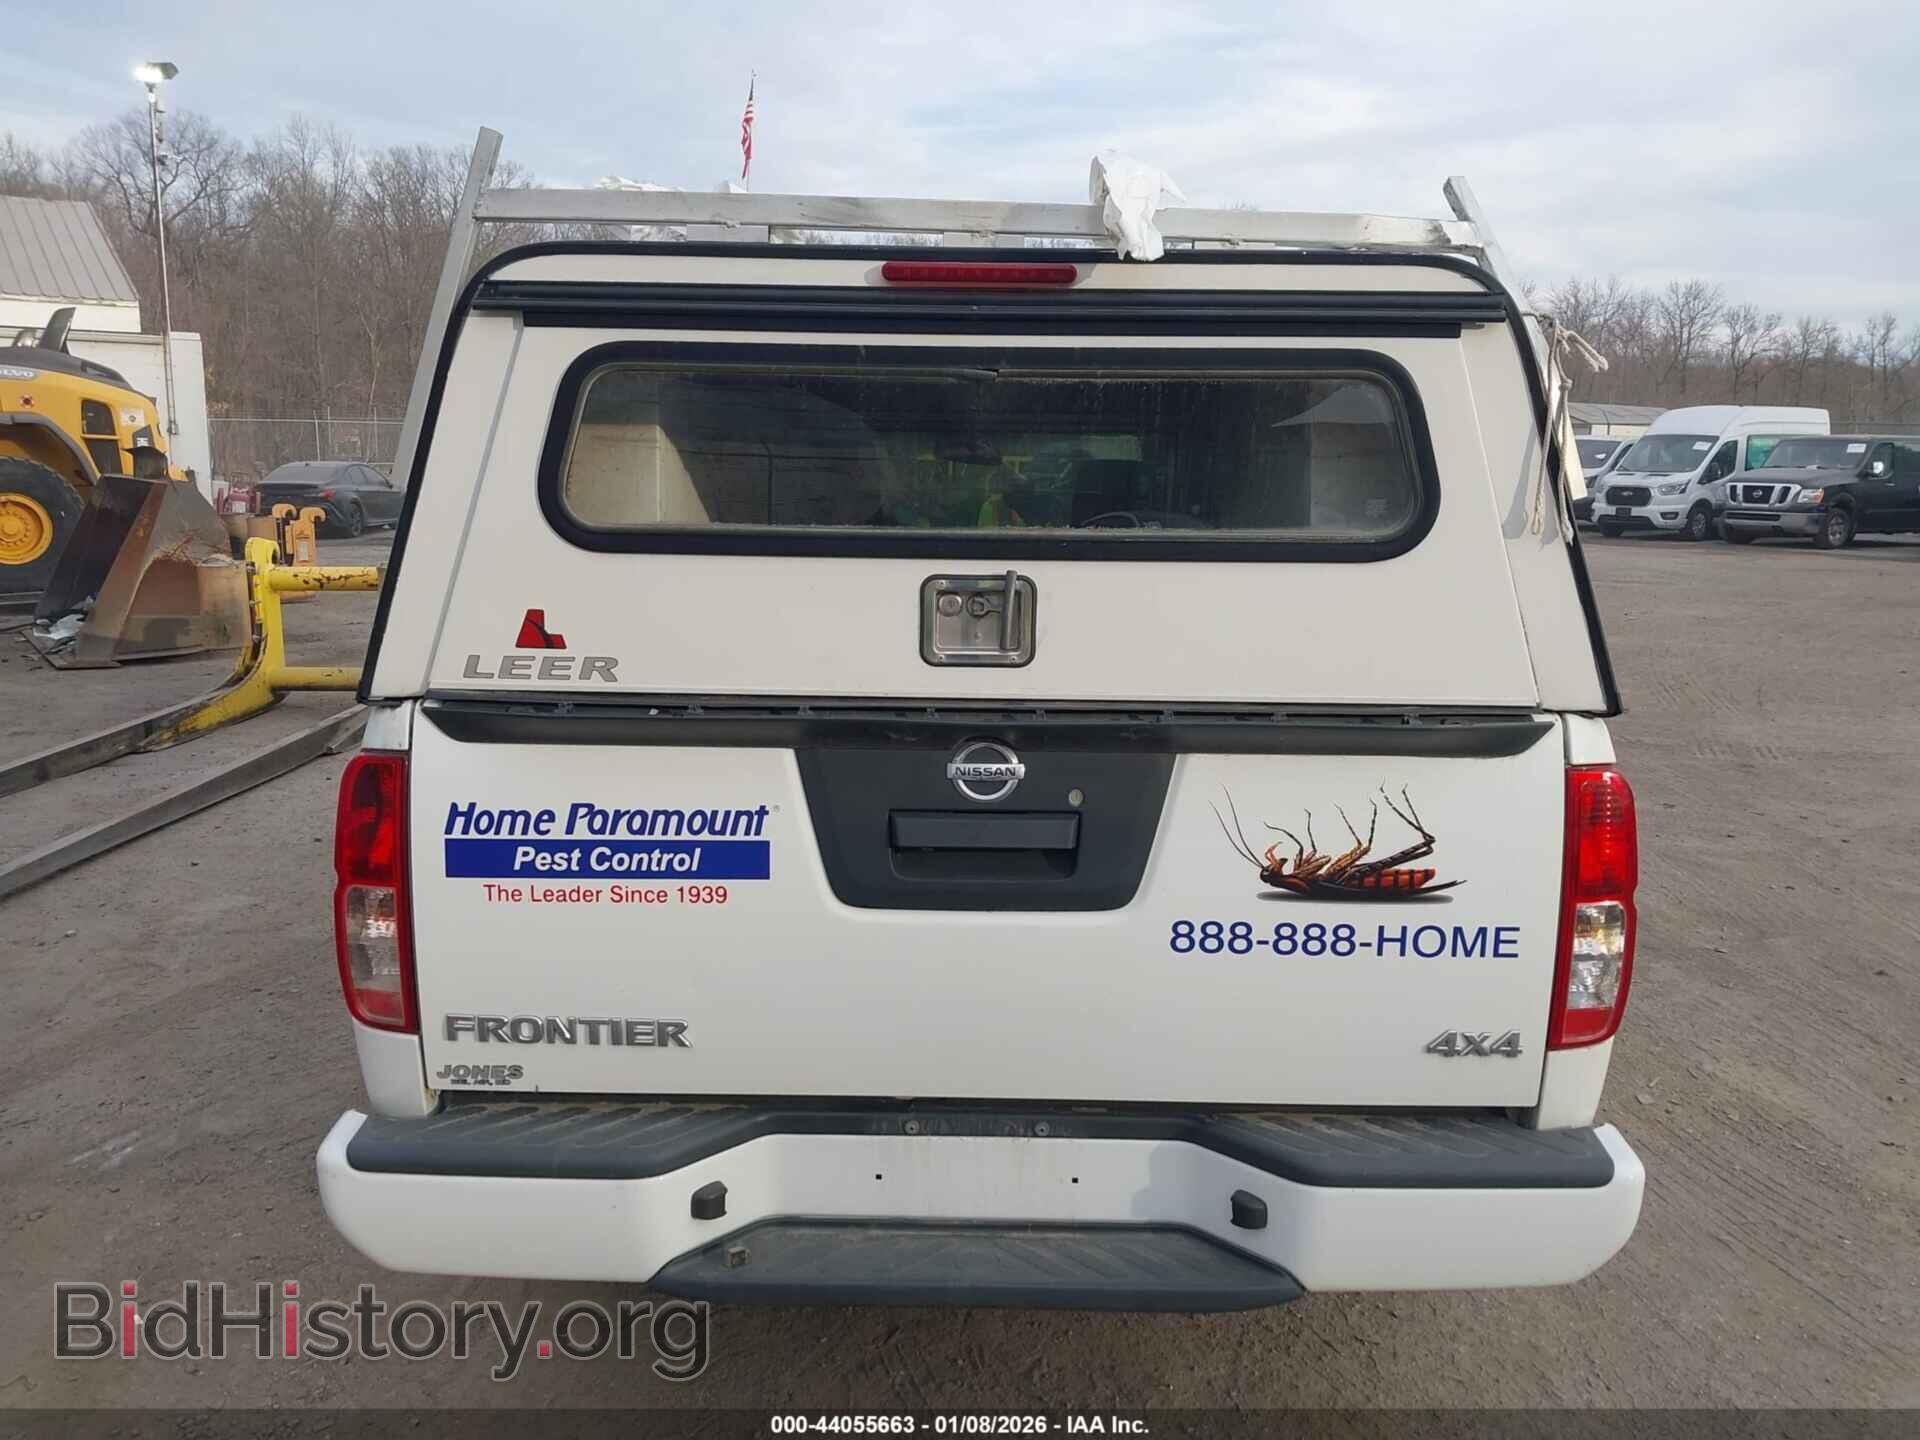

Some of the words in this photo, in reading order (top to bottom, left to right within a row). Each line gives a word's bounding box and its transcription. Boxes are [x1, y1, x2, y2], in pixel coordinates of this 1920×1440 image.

[0, 368, 34, 377] LVO
[463, 654, 619, 683] LEER
[955, 767, 1016, 777] NISSAN
[444, 802, 556, 836] Home
[565, 802, 769, 837] Paramount
[513, 846, 582, 871] Pest
[589, 847, 702, 872] Control
[484, 884, 523, 902] The
[530, 885, 602, 903] Leader
[609, 886, 668, 903] Since
[676, 886, 728, 904] 1939
[1170, 920, 1520, 959] 888-888-HOME
[445, 1014, 694, 1048] FRONTIER
[436, 1064, 524, 1080] JONES
